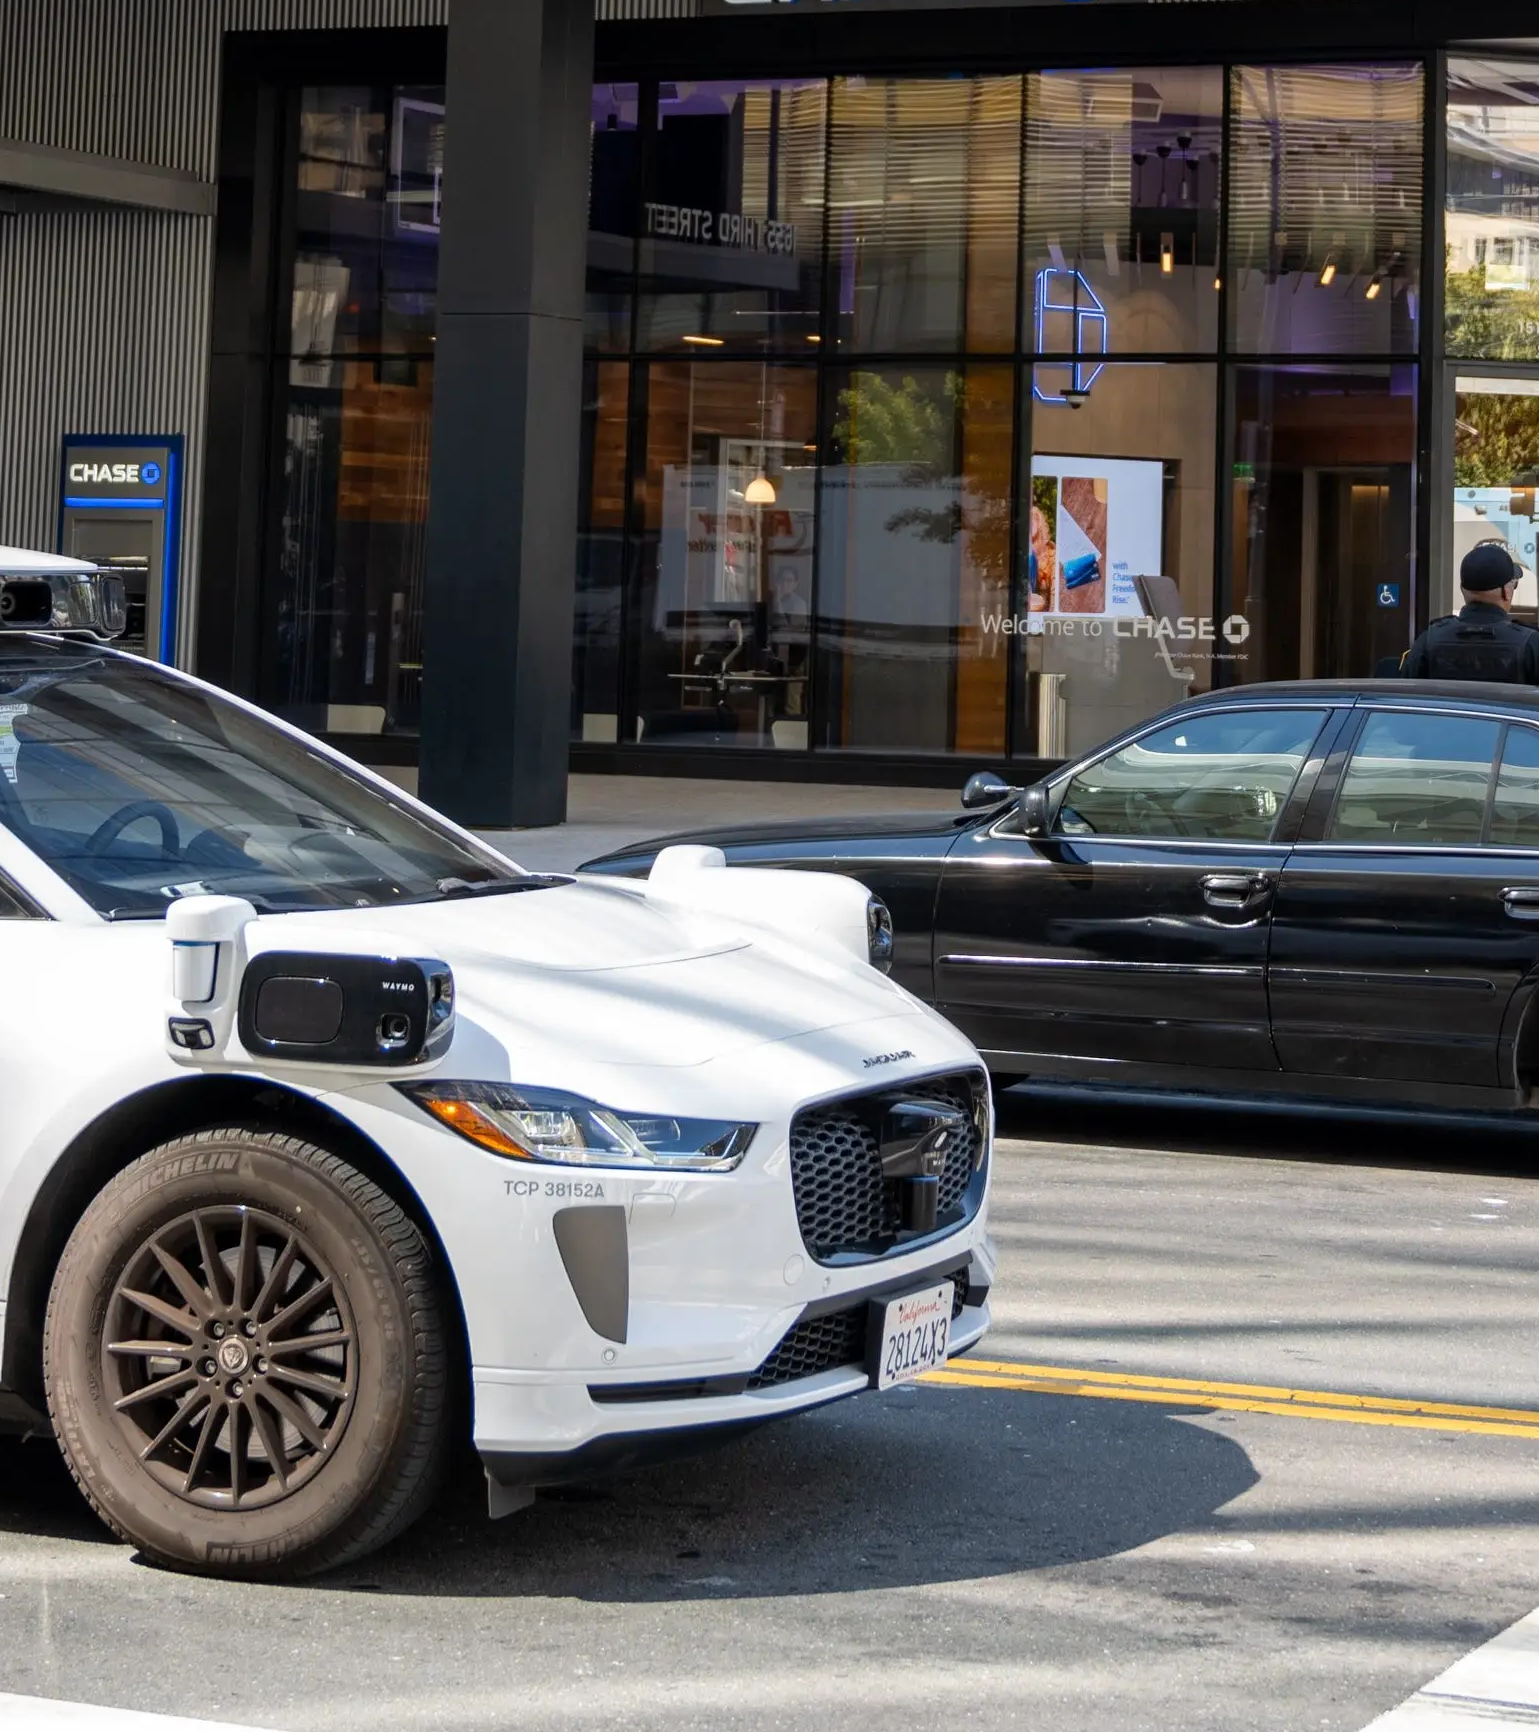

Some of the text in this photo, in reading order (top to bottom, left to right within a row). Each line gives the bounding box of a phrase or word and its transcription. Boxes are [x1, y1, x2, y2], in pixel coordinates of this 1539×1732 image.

[69, 463, 140, 483] CHASE
[980, 614, 1216, 640] Welcome to CHASE
[382, 981, 415, 991] WAYMO
[504, 1180, 605, 1198] TCP 38152A
[886, 1317, 947, 1376] 28124X3
